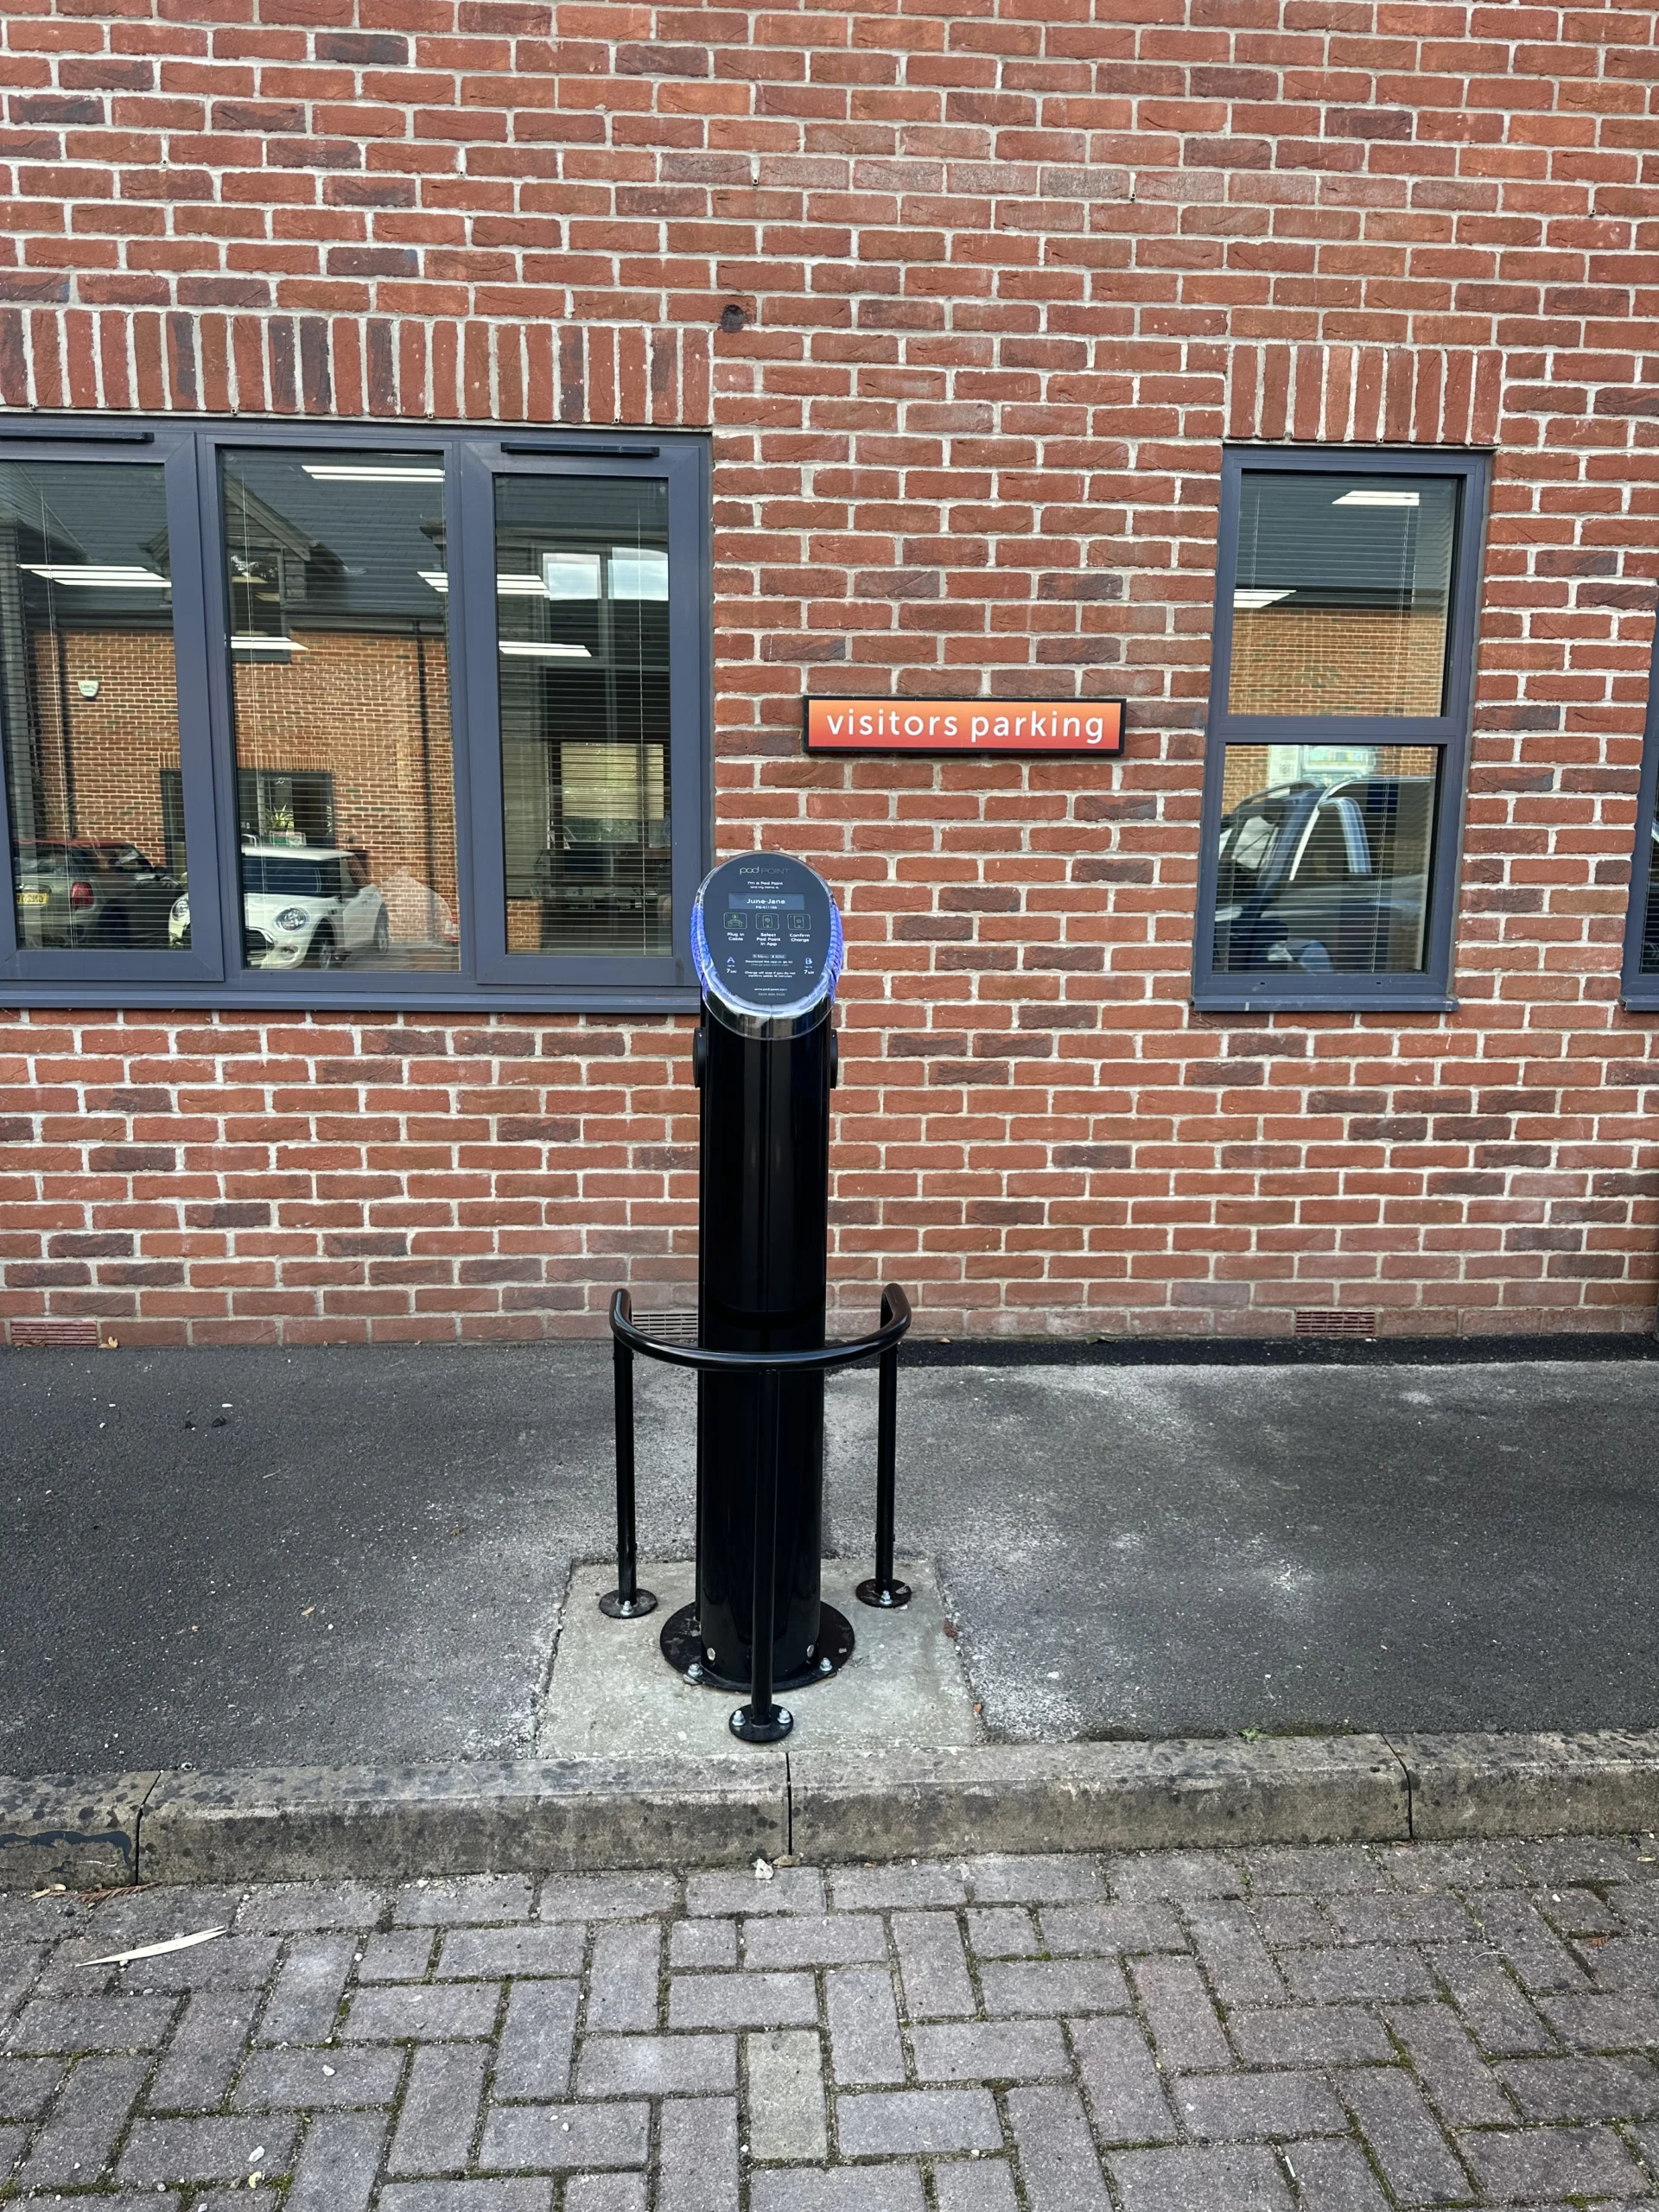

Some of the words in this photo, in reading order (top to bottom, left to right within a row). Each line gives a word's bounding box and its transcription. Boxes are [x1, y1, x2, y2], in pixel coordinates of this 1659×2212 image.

[826, 709, 958, 736] visitors
[971, 710, 1103, 744] parking
[740, 866, 760, 875] pod
